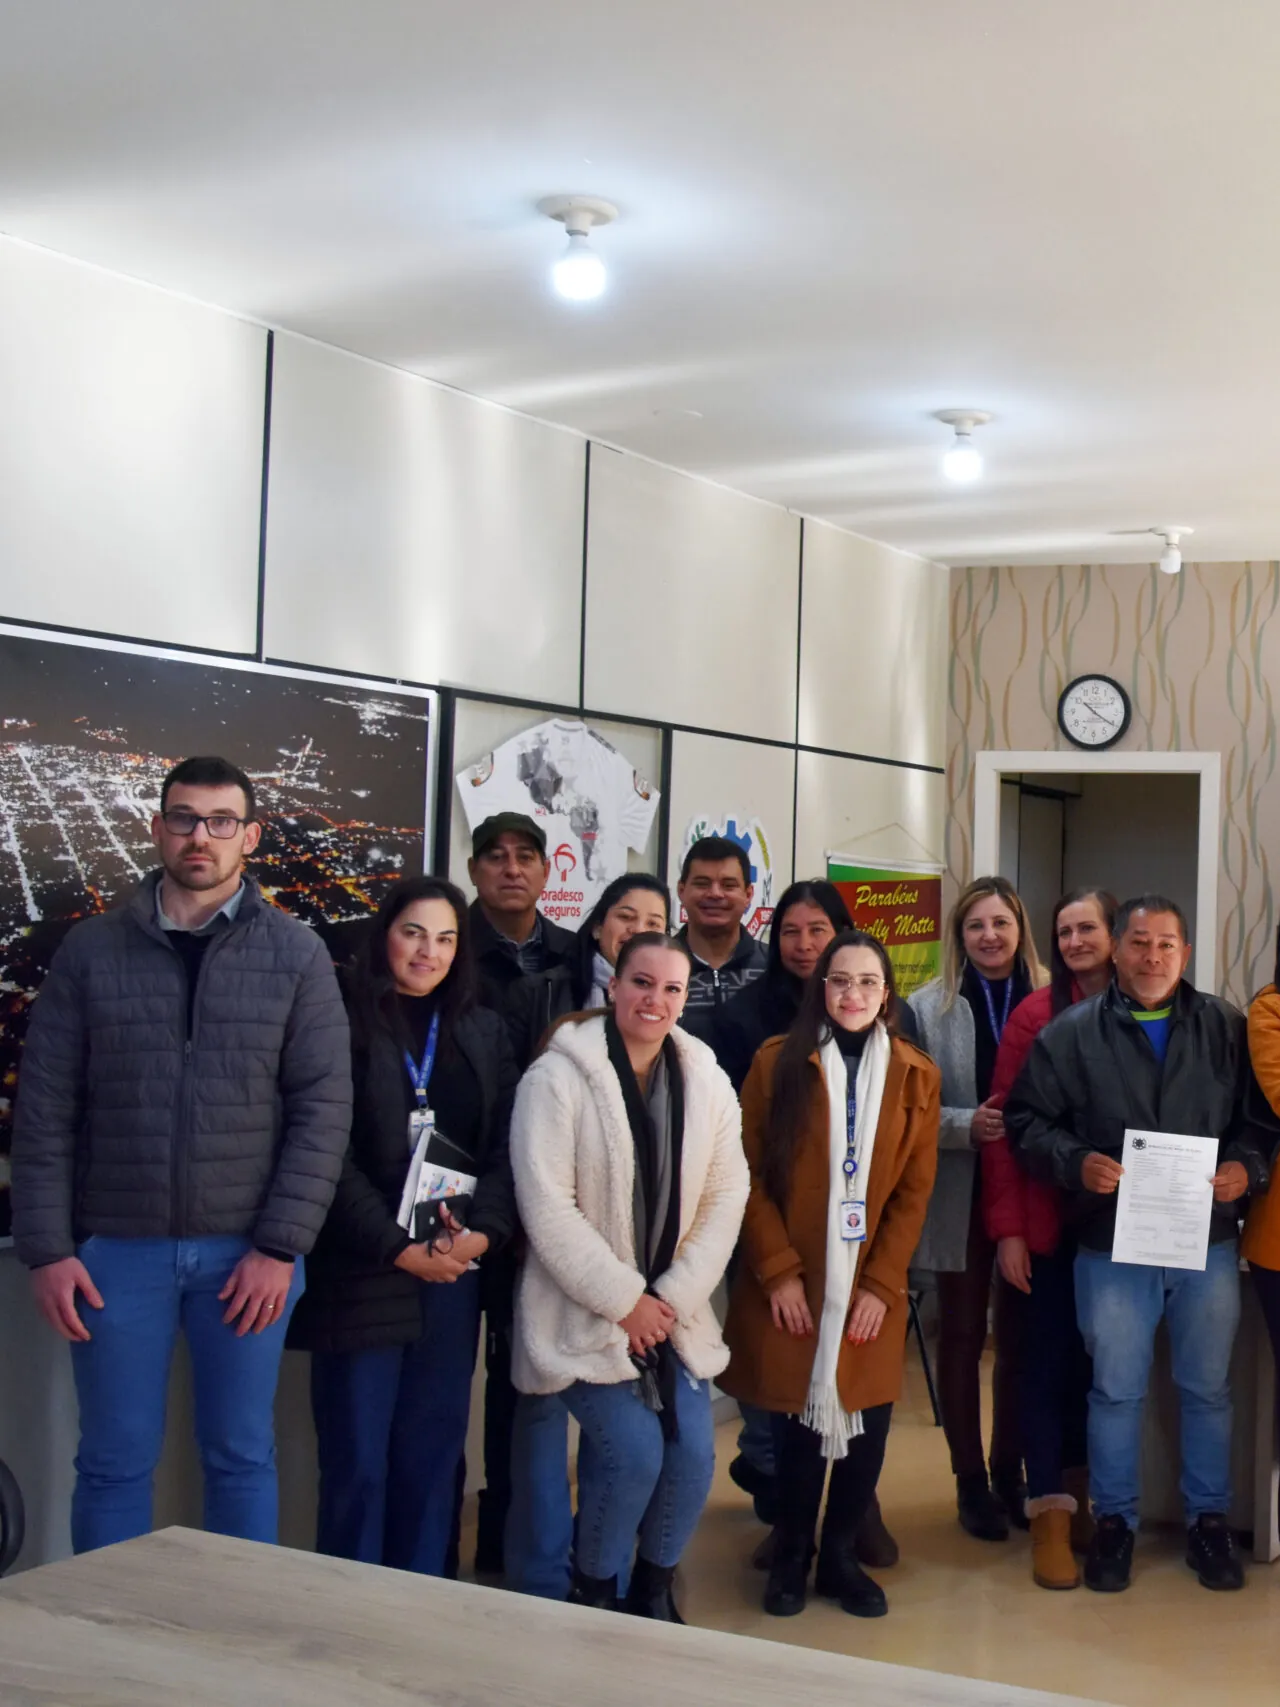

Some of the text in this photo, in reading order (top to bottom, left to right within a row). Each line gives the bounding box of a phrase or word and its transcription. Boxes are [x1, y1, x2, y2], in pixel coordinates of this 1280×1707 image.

[854, 883, 919, 911] Parabéns
[543, 905, 581, 920] seguros
[894, 914, 935, 936] Motta
